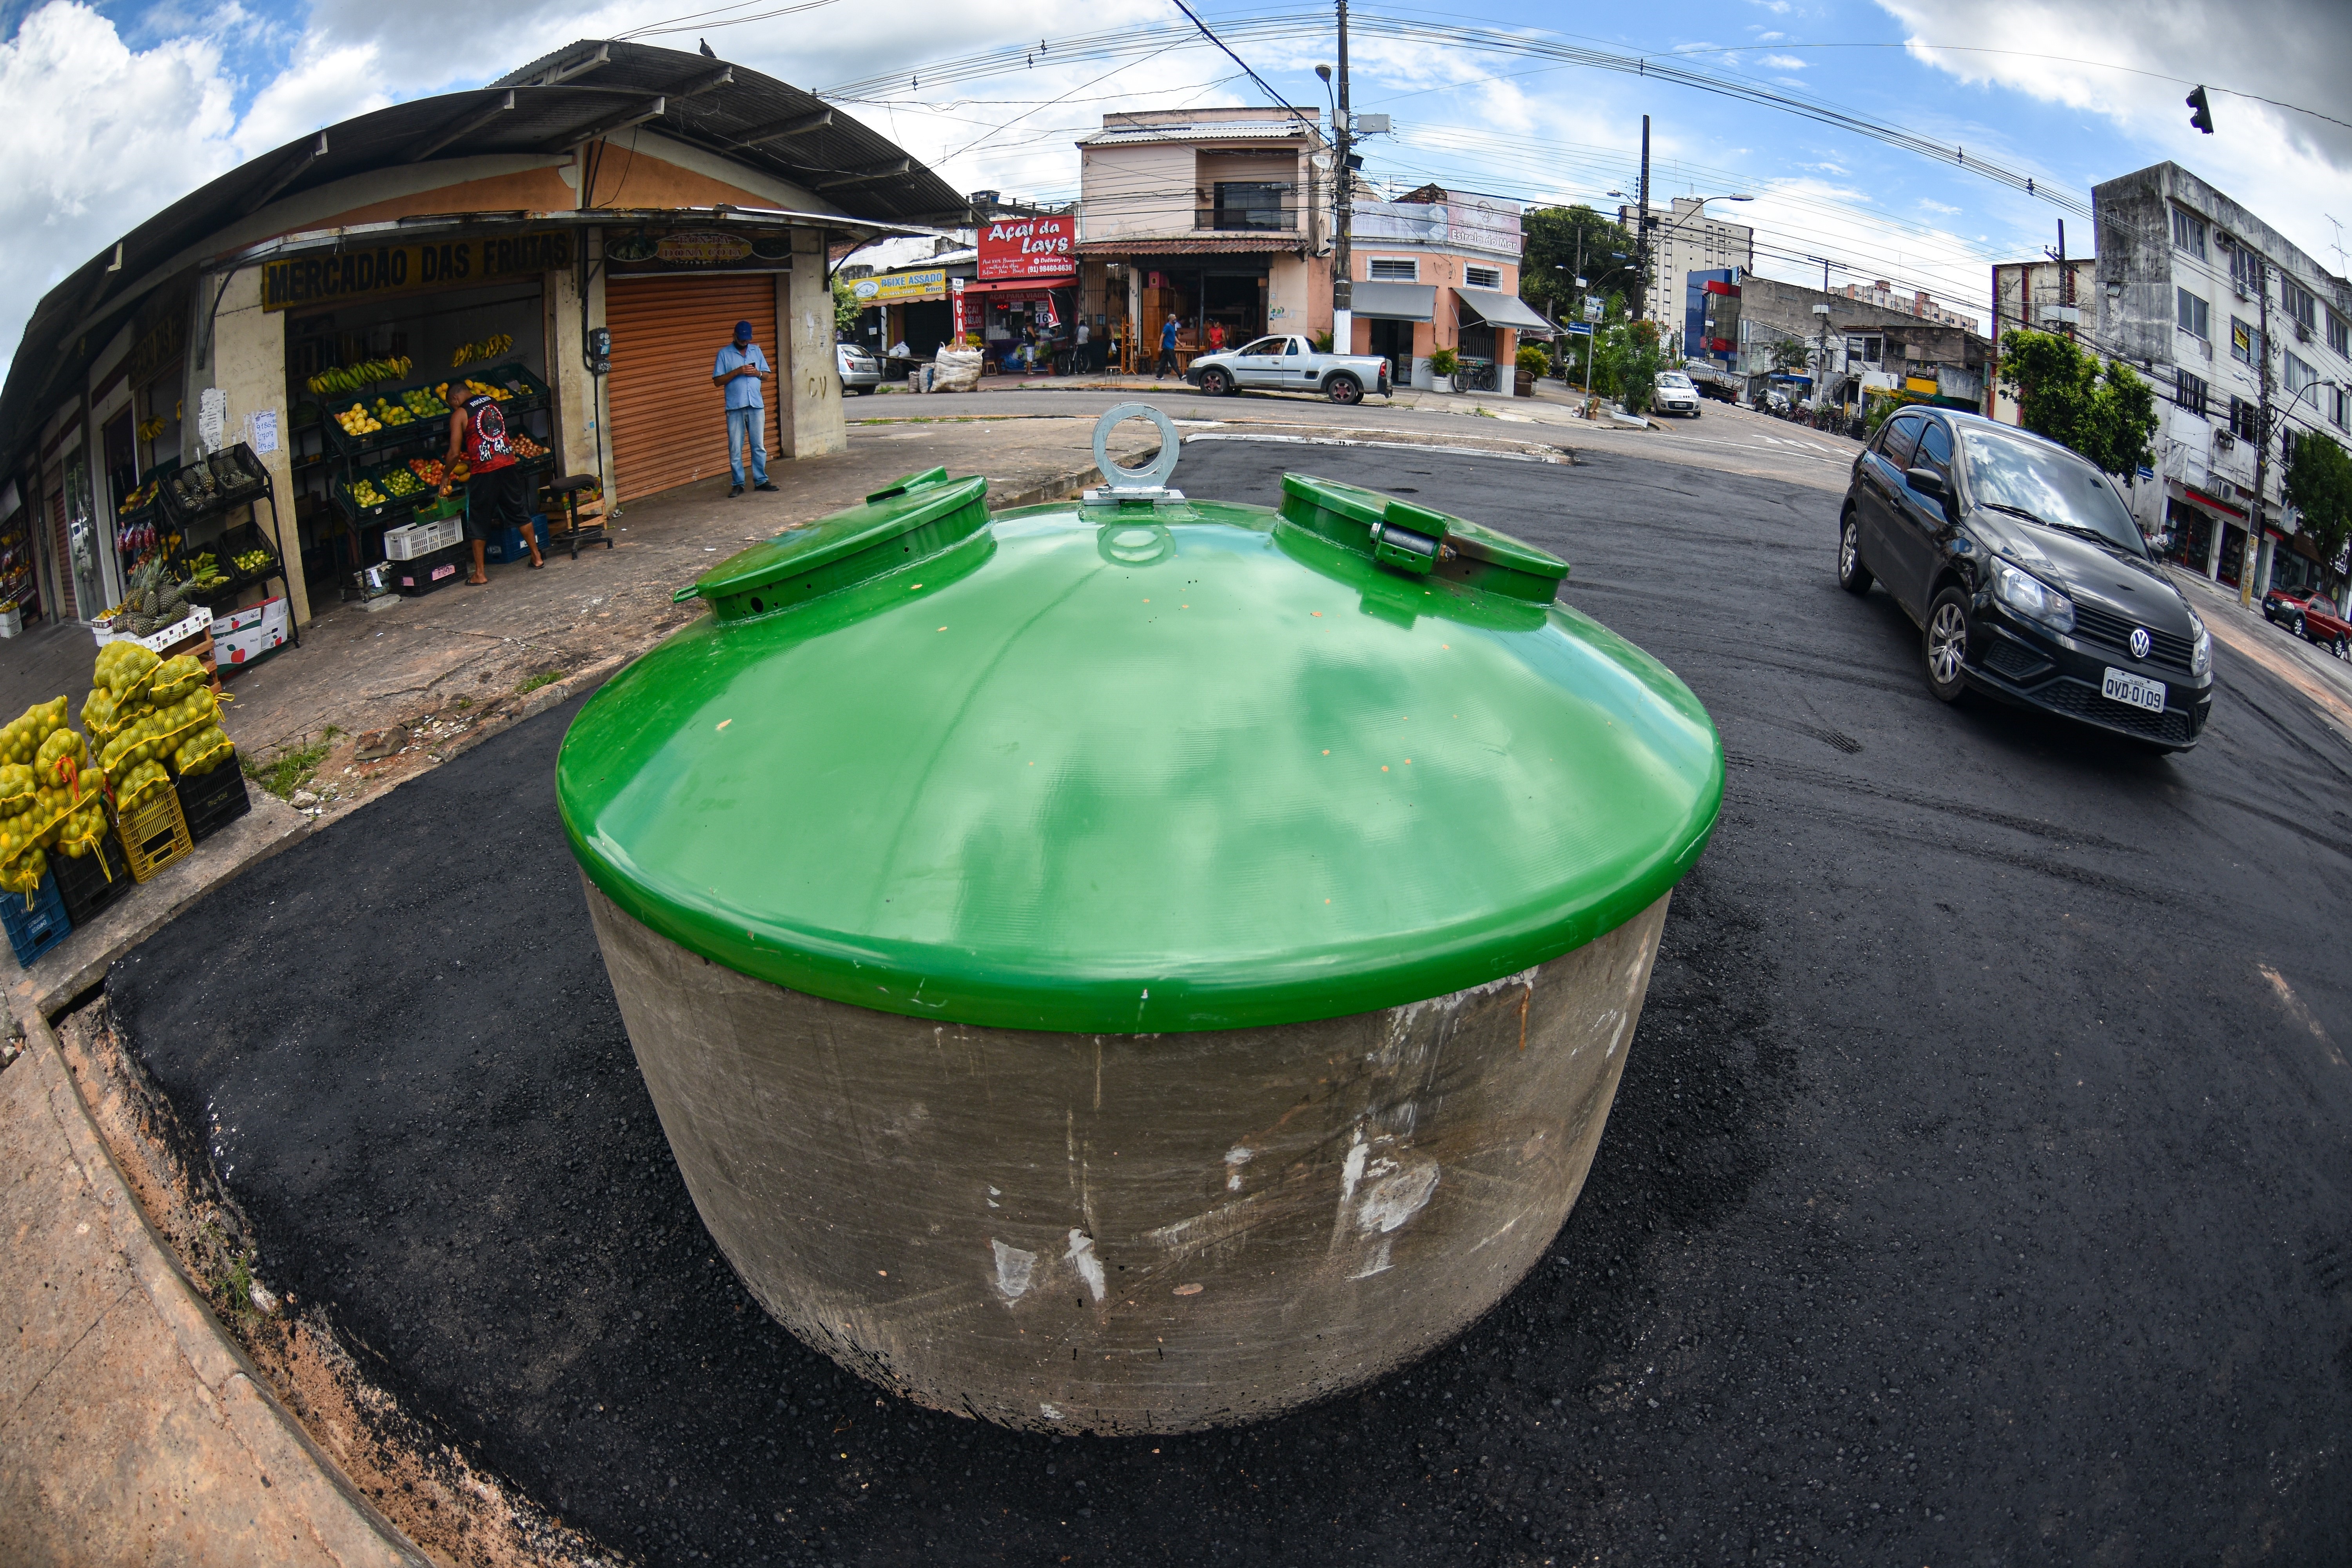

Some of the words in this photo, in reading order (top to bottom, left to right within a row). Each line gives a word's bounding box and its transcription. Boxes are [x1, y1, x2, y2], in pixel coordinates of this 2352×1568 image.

[1039, 220, 1060, 234] da
[678, 236, 708, 245] BOX
[710, 236, 730, 245] DA
[1452, 229, 1483, 244] Estrela
[1485, 235, 1497, 246] do
[1499, 237, 1517, 249] Mar
[1022, 237, 1068, 256] Lays
[664, 249, 704, 258] DONA
[708, 248, 744, 257] COTA
[268, 247, 407, 305] MERCADÃO
[421, 243, 470, 283] DAS
[483, 233, 568, 275] FRUTAS
[1028, 265, 1038, 274] (91)
[1039, 264, 1072, 272] 98460-6636
[882, 277, 906, 288] PEIXE
[909, 273, 943, 285] ASSADO
[1036, 314, 1048, 323] 16
[470, 396, 491, 407] ROGÉRIO
